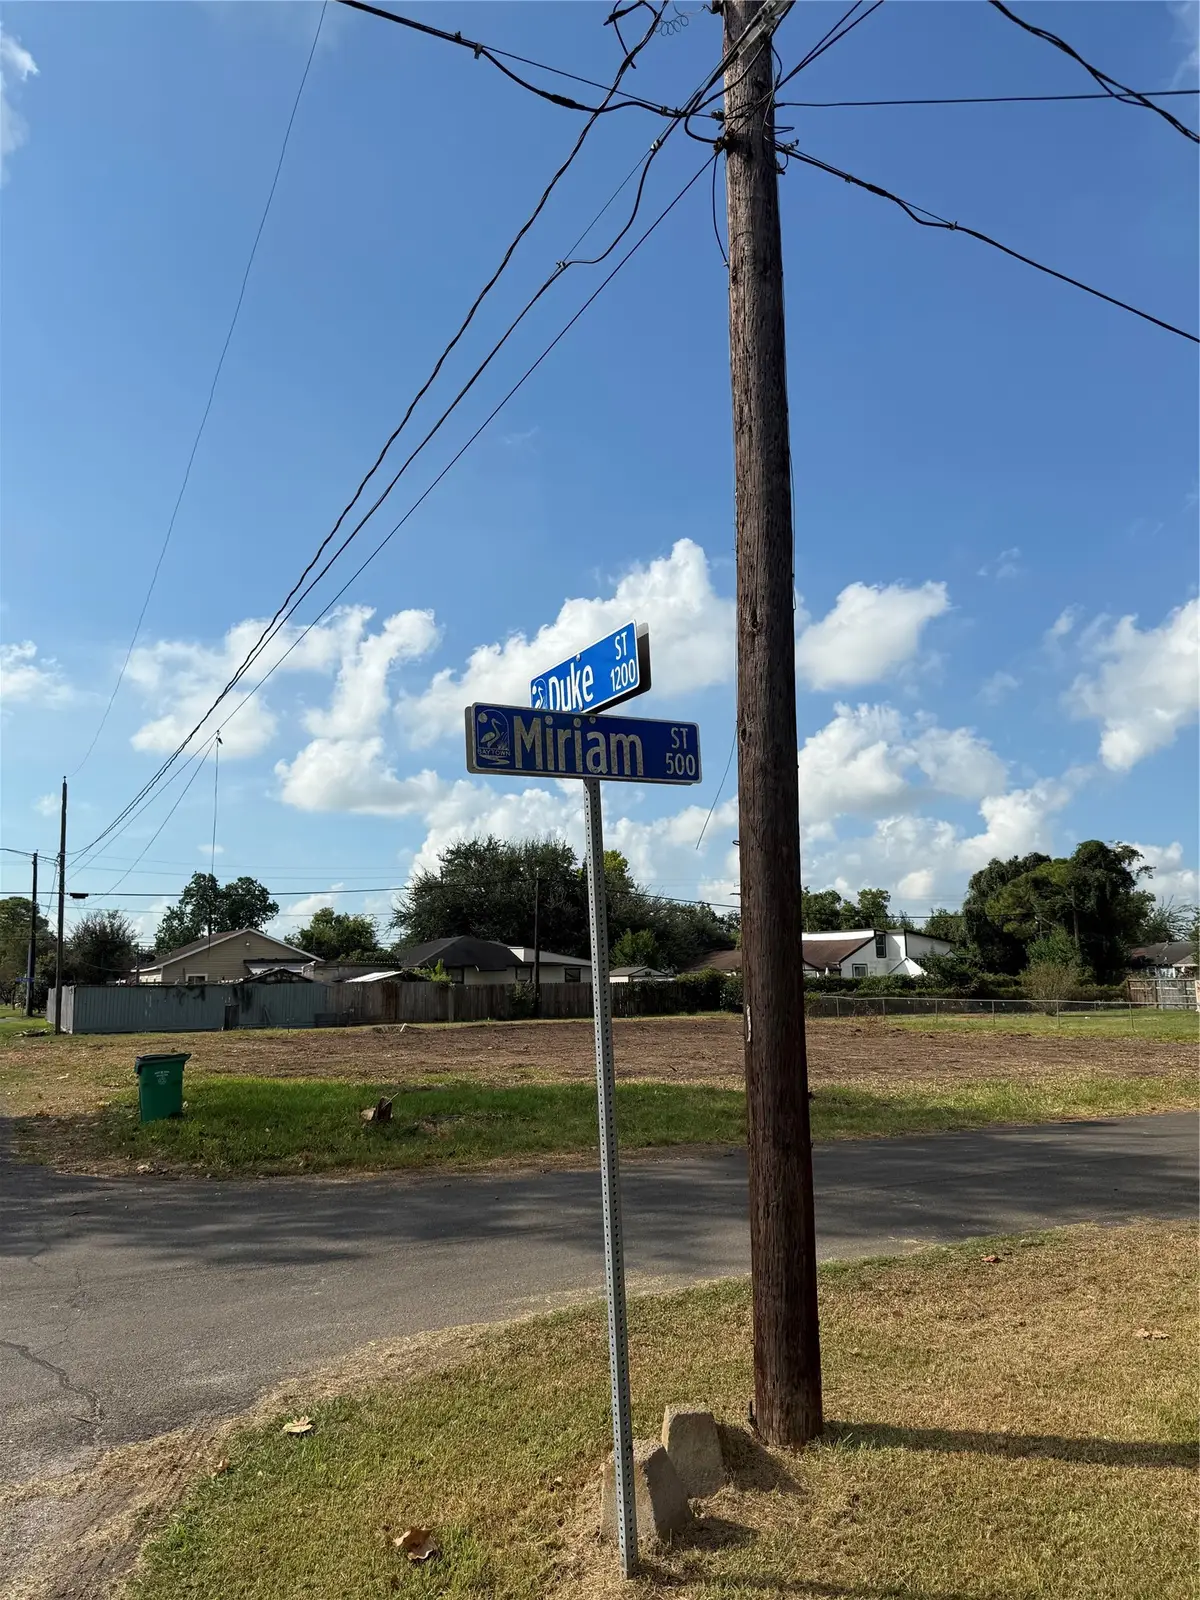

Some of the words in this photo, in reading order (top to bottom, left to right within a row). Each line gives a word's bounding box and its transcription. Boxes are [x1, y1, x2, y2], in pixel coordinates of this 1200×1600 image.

[614, 631, 628, 660] ST
[549, 662, 594, 711] Duke
[610, 658, 636, 692] 1200
[477, 748, 511, 757] BAYTOWN
[513, 715, 644, 776] Miriam
[671, 727, 689, 750] ST
[665, 752, 696, 776] 500
